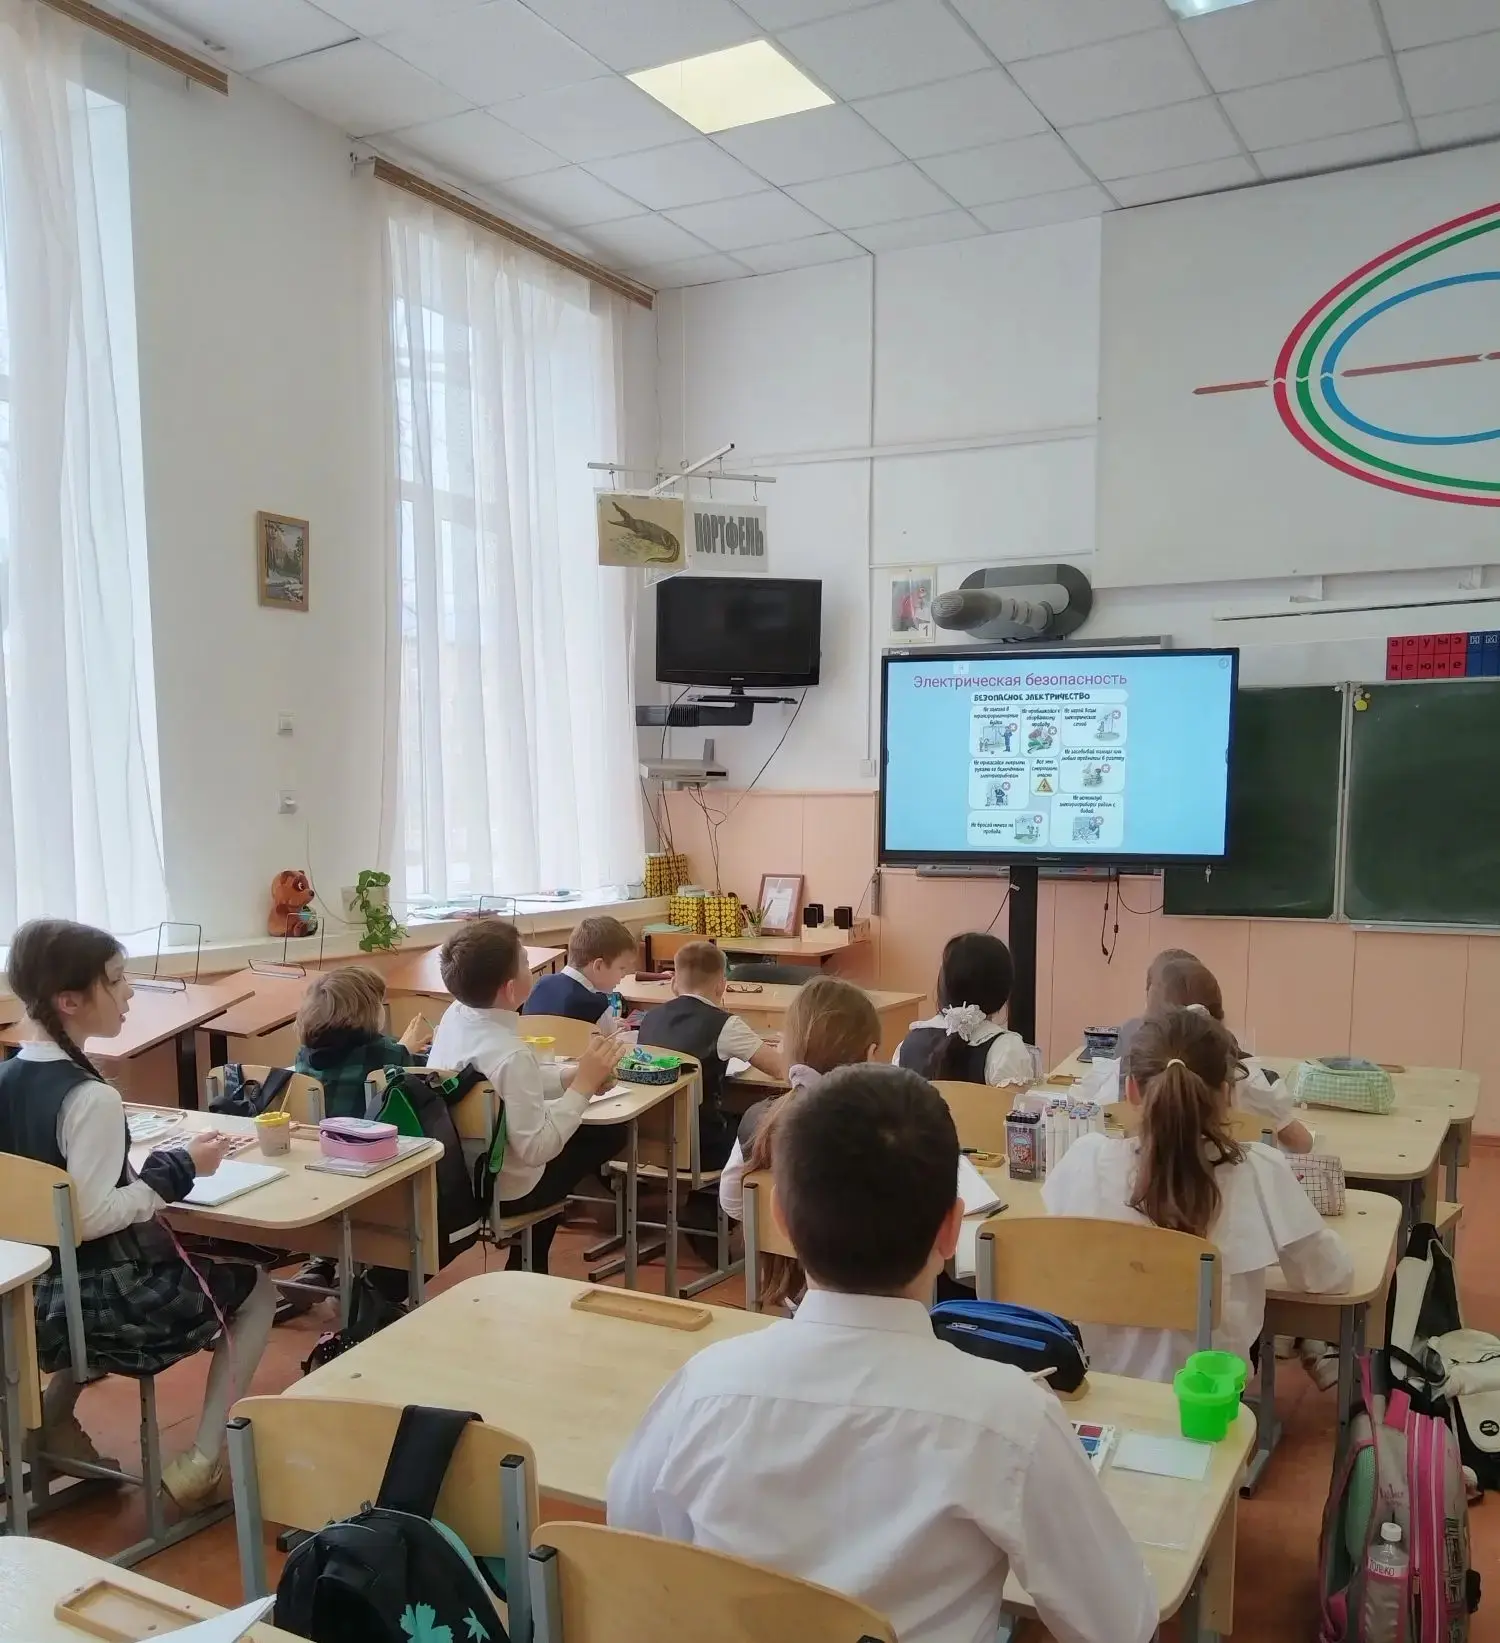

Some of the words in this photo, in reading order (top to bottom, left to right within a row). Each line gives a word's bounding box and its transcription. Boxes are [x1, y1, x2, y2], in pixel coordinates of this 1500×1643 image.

[694, 513, 764, 556] ПОРТФЕЛЬ
[1424, 638, 1430, 648] у
[1486, 635, 1498, 644] М
[914, 674, 1020, 690] Электрическая
[1026, 673, 1127, 686] безопасность
[974, 694, 1023, 702] БЕЗОПАСНОЕ
[1025, 692, 1090, 701] ЭЛЕКТРИЧЕСТВО
